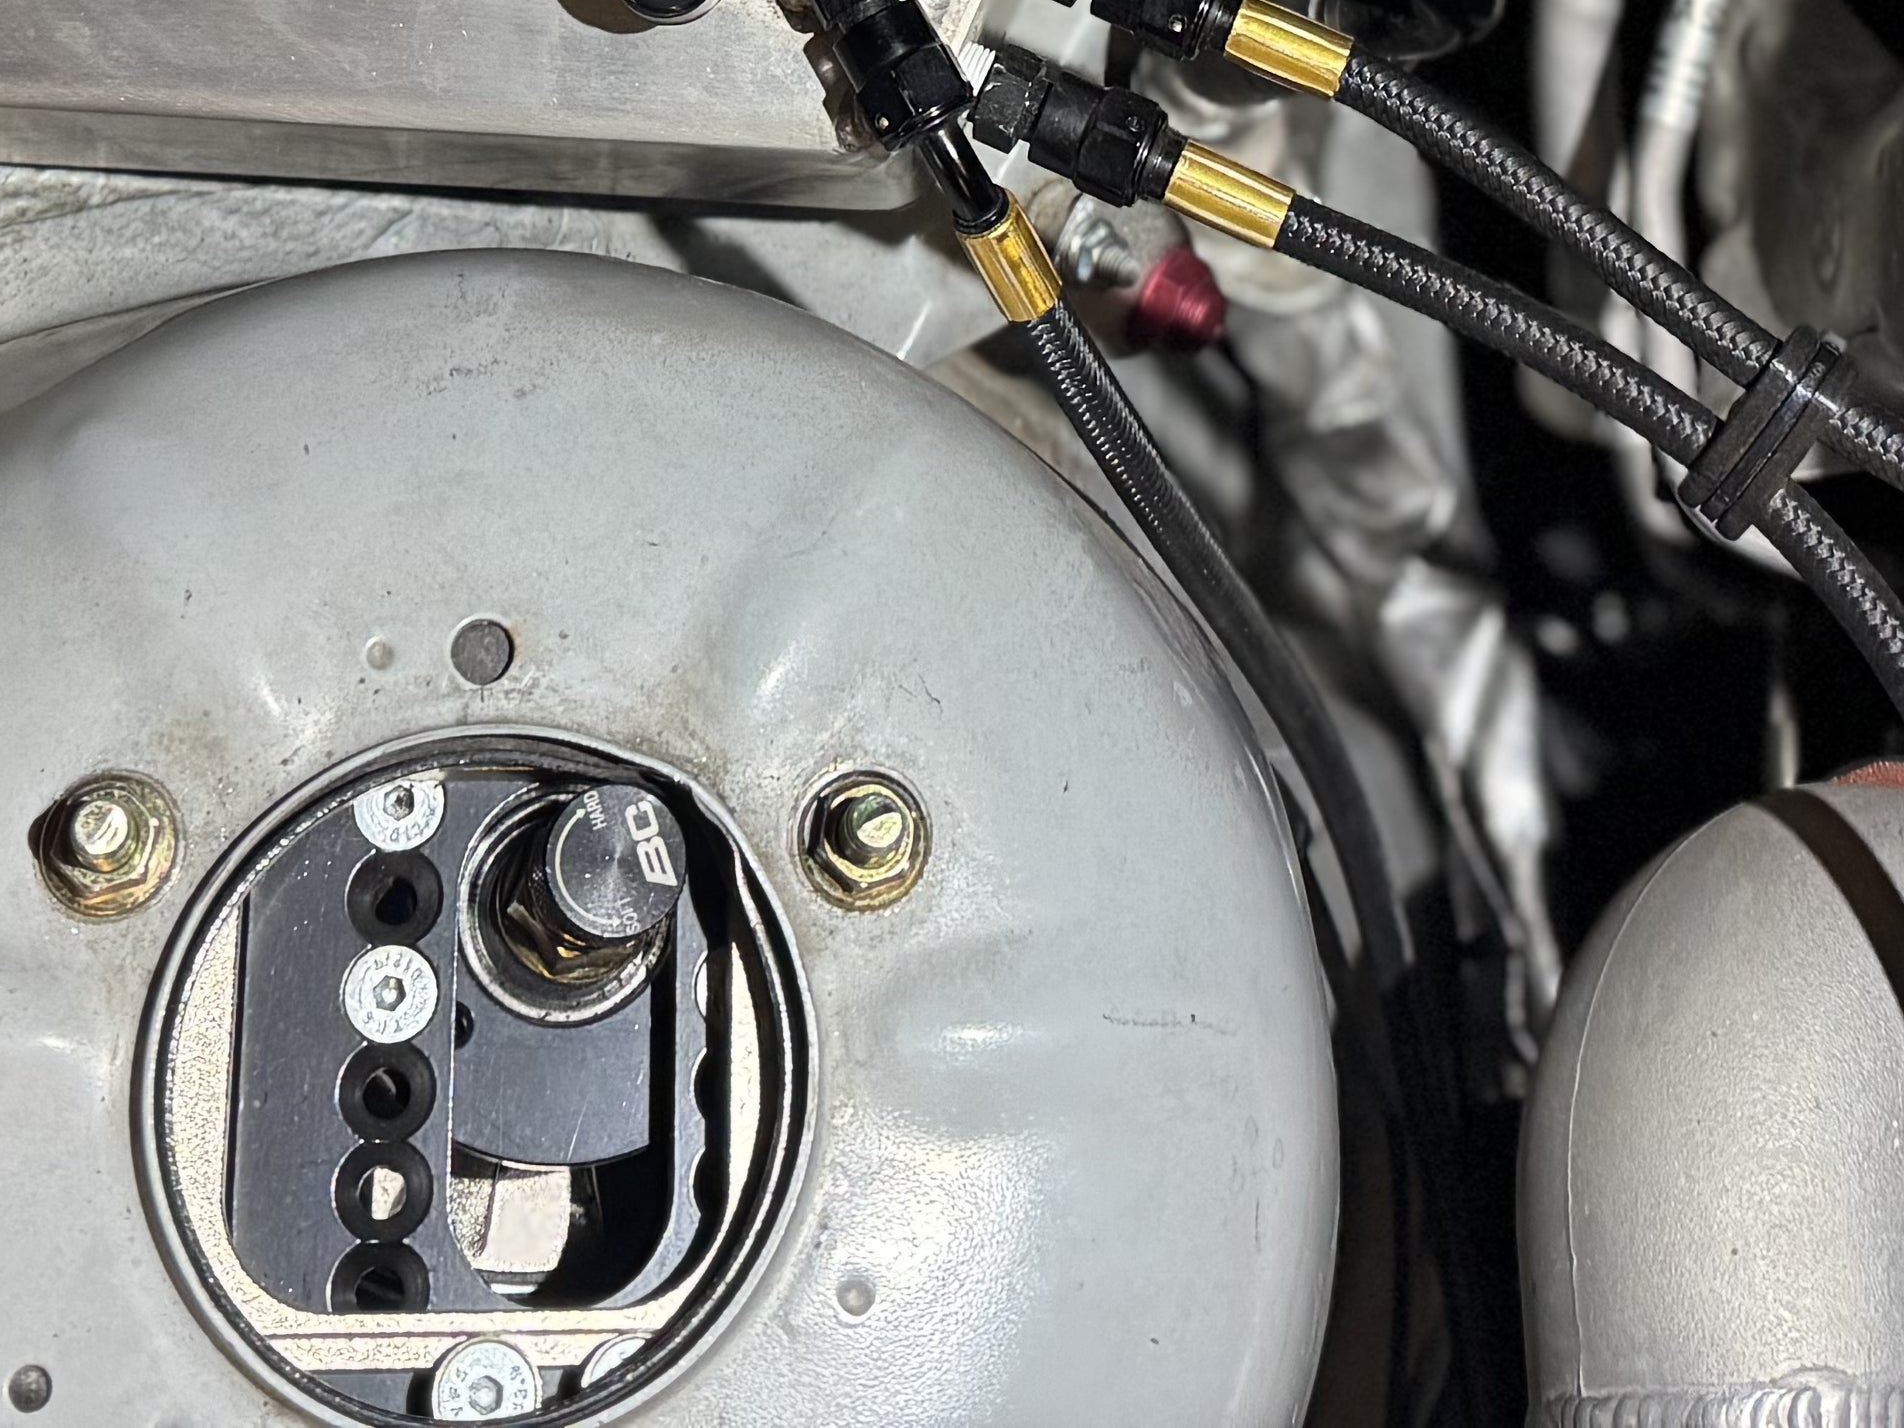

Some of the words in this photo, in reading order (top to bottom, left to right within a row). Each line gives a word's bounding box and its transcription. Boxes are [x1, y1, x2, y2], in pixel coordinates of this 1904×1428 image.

[583, 790, 607, 831] HARD
[624, 799, 679, 887] BC
[614, 896, 642, 937] SOFT
